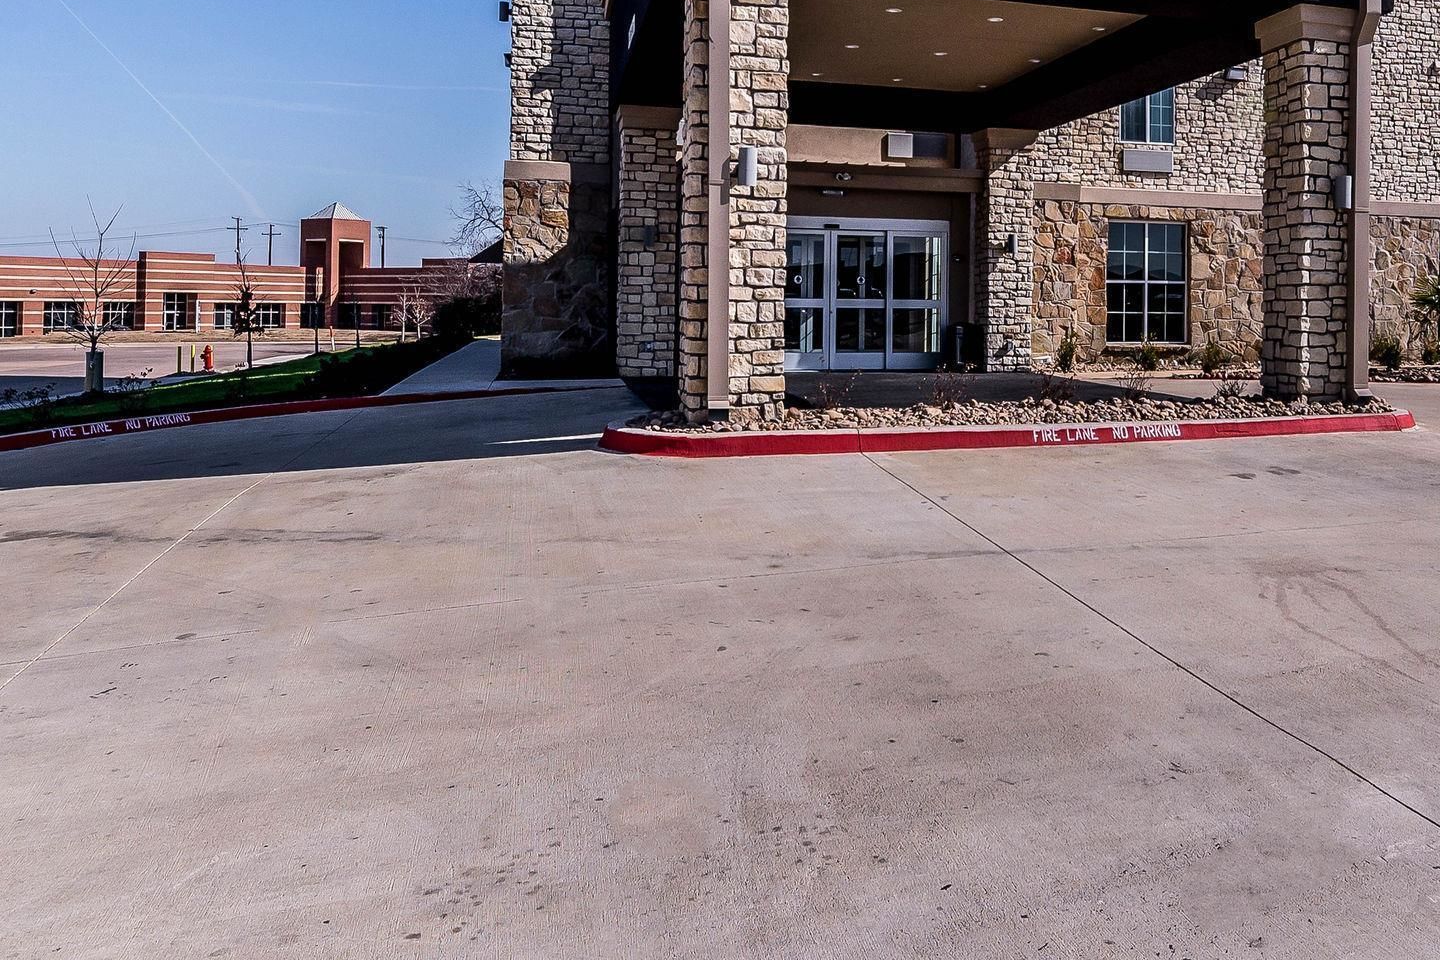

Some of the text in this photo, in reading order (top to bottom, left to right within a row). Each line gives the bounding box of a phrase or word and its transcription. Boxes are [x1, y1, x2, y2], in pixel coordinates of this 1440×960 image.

[51, 413, 191, 439] FIRE LANE NO PARKING
[1032, 424, 1182, 442] FIRE LANE NO PARKING
